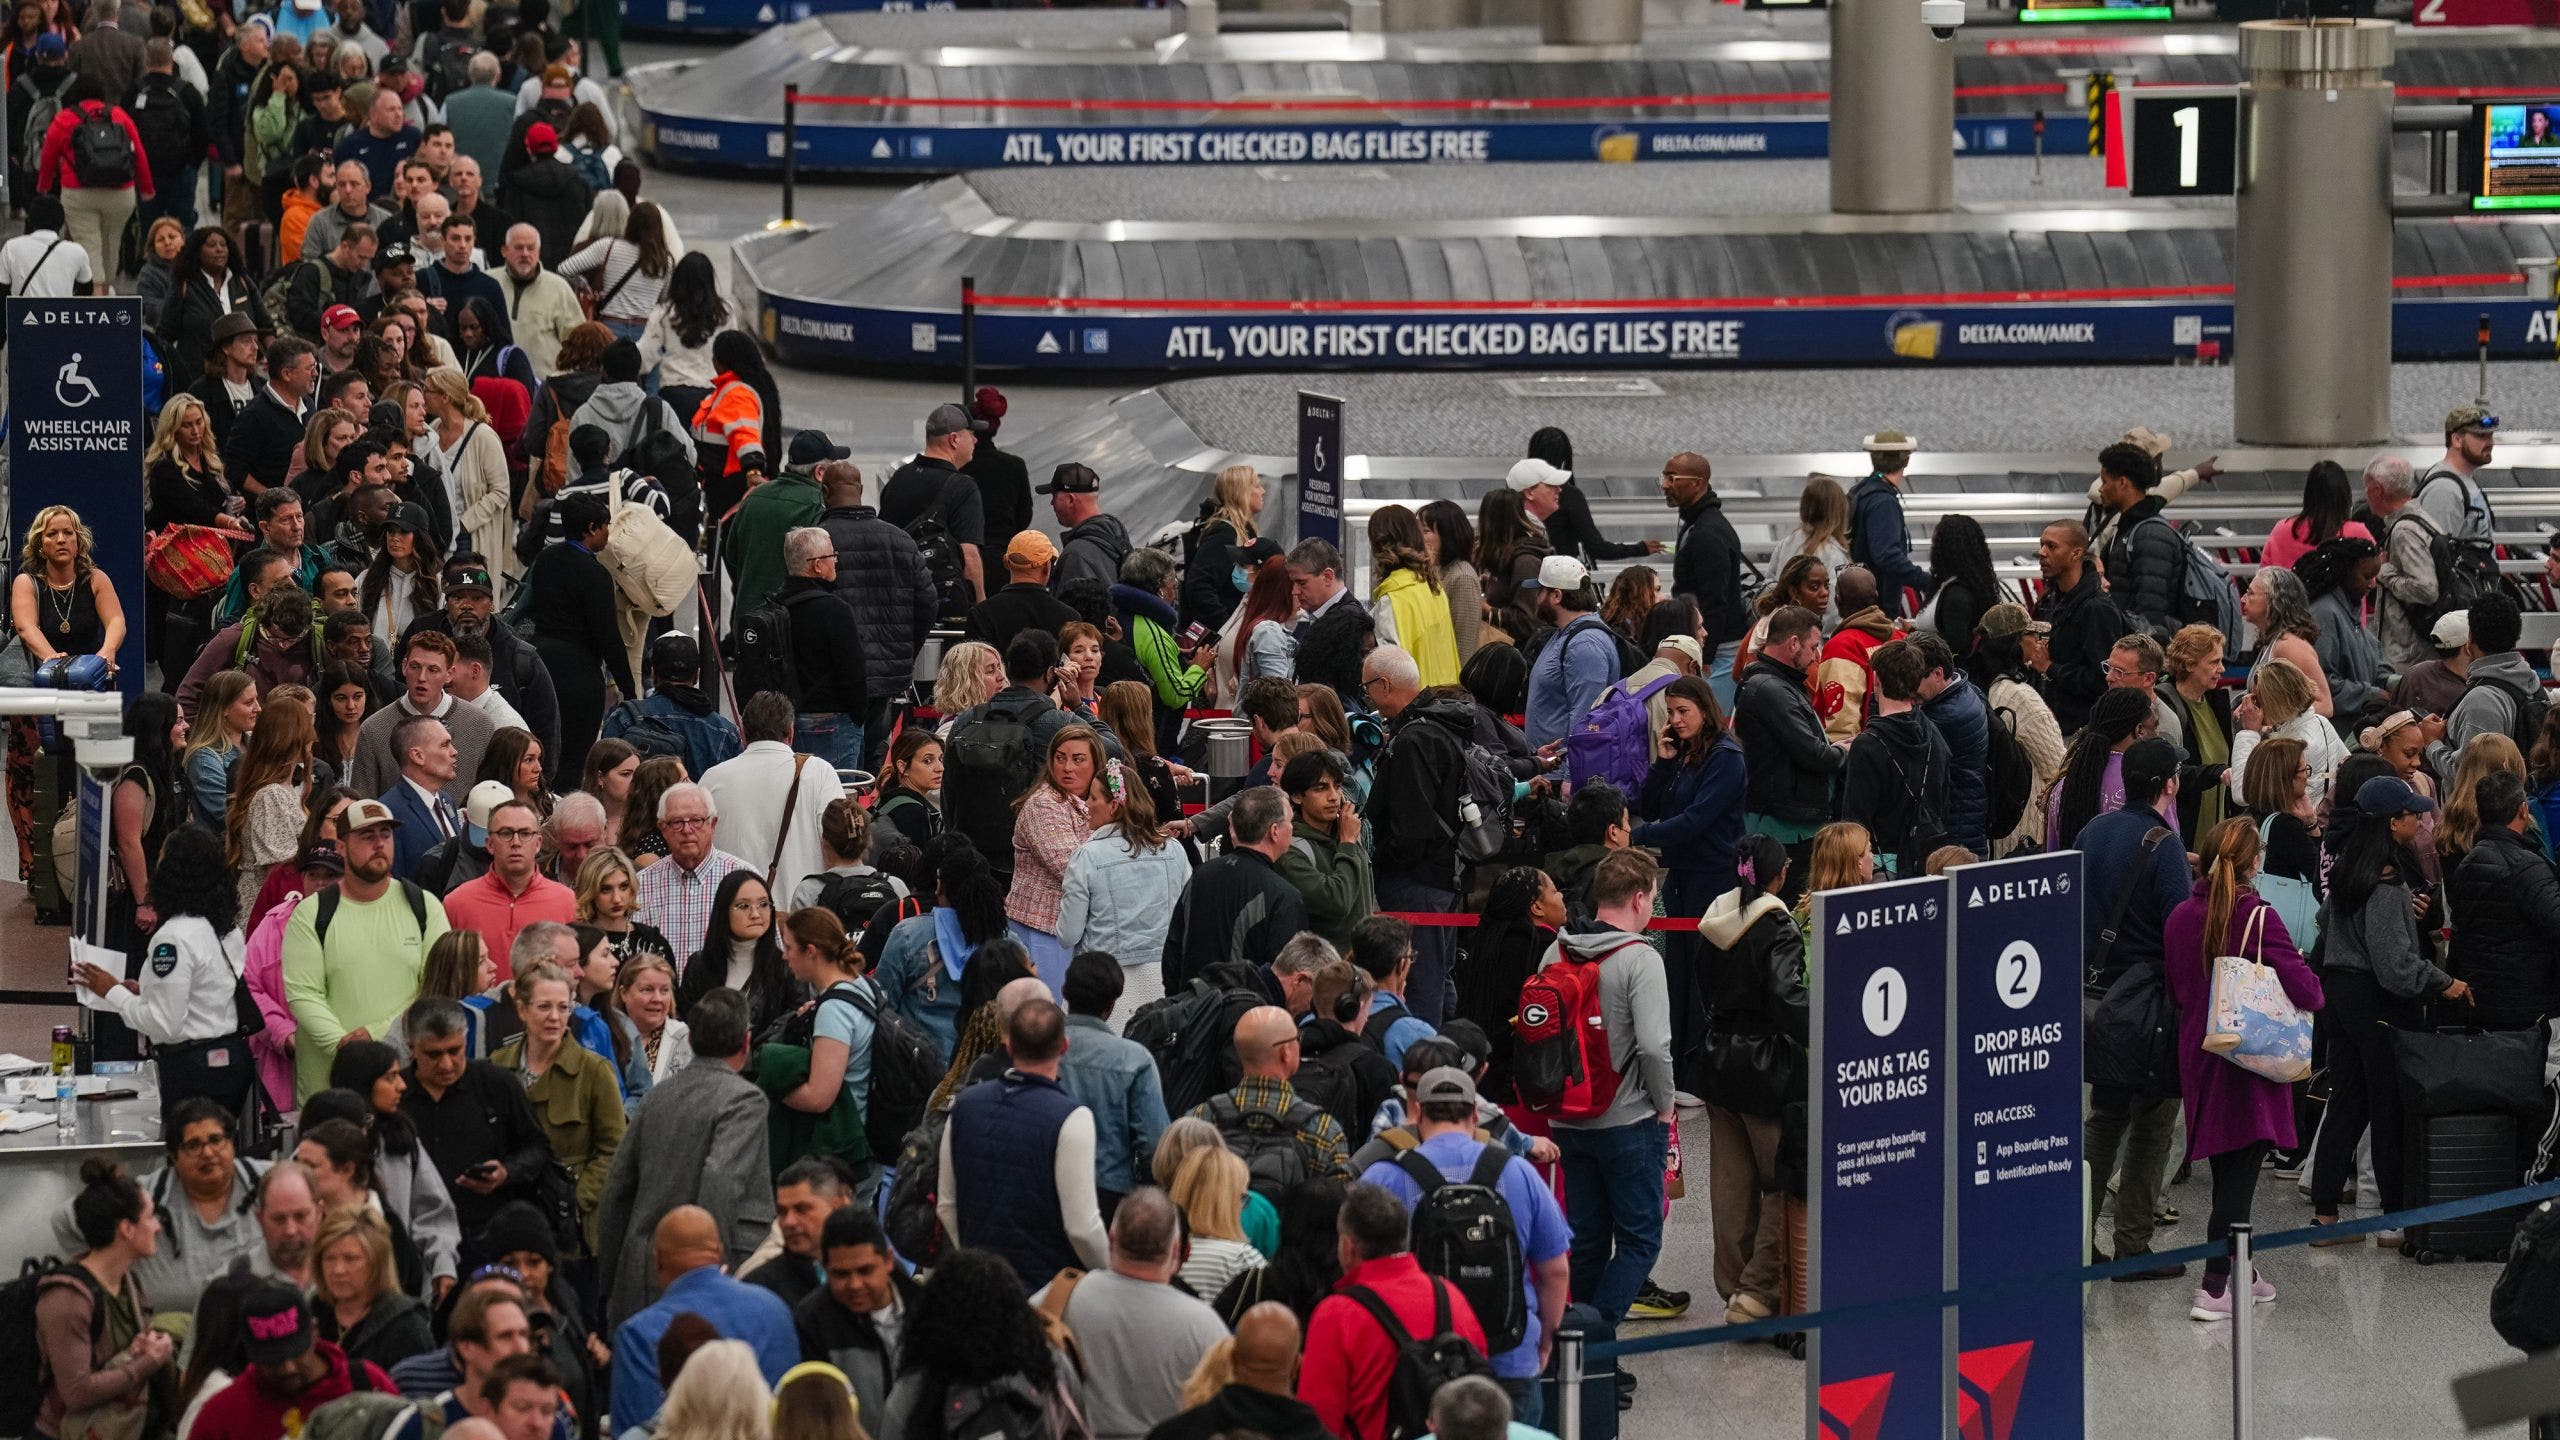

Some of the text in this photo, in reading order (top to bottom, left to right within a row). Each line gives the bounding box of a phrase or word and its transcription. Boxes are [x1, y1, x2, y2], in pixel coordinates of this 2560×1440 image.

[2419, 0, 2447, 22] 2
[1002, 133, 1054, 165] ATL,
[1056, 133, 1125, 162] YOUR
[1129, 133, 1194, 162] FIRST
[1198, 132, 1308, 161] CHECKED
[1312, 131, 1362, 161] BAG
[1364, 131, 1428, 161] FLIES
[2172, 106, 2199, 188] 1
[44, 311, 110, 324] DELTA
[1166, 325, 1225, 361] ATL,
[1229, 325, 1309, 357] YOUR
[1315, 324, 1391, 356] FIRST
[1395, 323, 1525, 356] CHECKED
[1530, 322, 1589, 355] BAG
[1594, 322, 1666, 354] FLIES
[1958, 323, 2095, 345] DELTA.COM/AMEX
[1312, 406, 1329, 419] DELTA
[24, 420, 132, 434] WHEELCHAIR
[28, 437, 129, 451] ASSISTANCE
[1309, 478, 1330, 493] RESERVED
[1988, 876, 2051, 904] DELTA
[1856, 902, 1919, 931] DELTA
[2009, 954, 2028, 996] 2
[1878, 981, 1889, 1021] 1
[1522, 1003, 1549, 1027] G
[1974, 1022, 2062, 1055] DROP BAGS
[1836, 1048, 1930, 1084] SCAN & TAG
[1986, 1049, 2050, 1077] WITH ID
[1838, 1074, 1928, 1108] YOUR BAGS
[1974, 1104, 2036, 1126] FOR ACCESS:
[1837, 1130, 1926, 1155] Scan your app boarding
[1996, 1135, 2069, 1158] App Boarding Pass
[1837, 1146, 1916, 1172] pass at kiosk to print
[1996, 1158, 2072, 1182] Identification Ready
[1837, 1171, 1872, 1187] bag tags.
